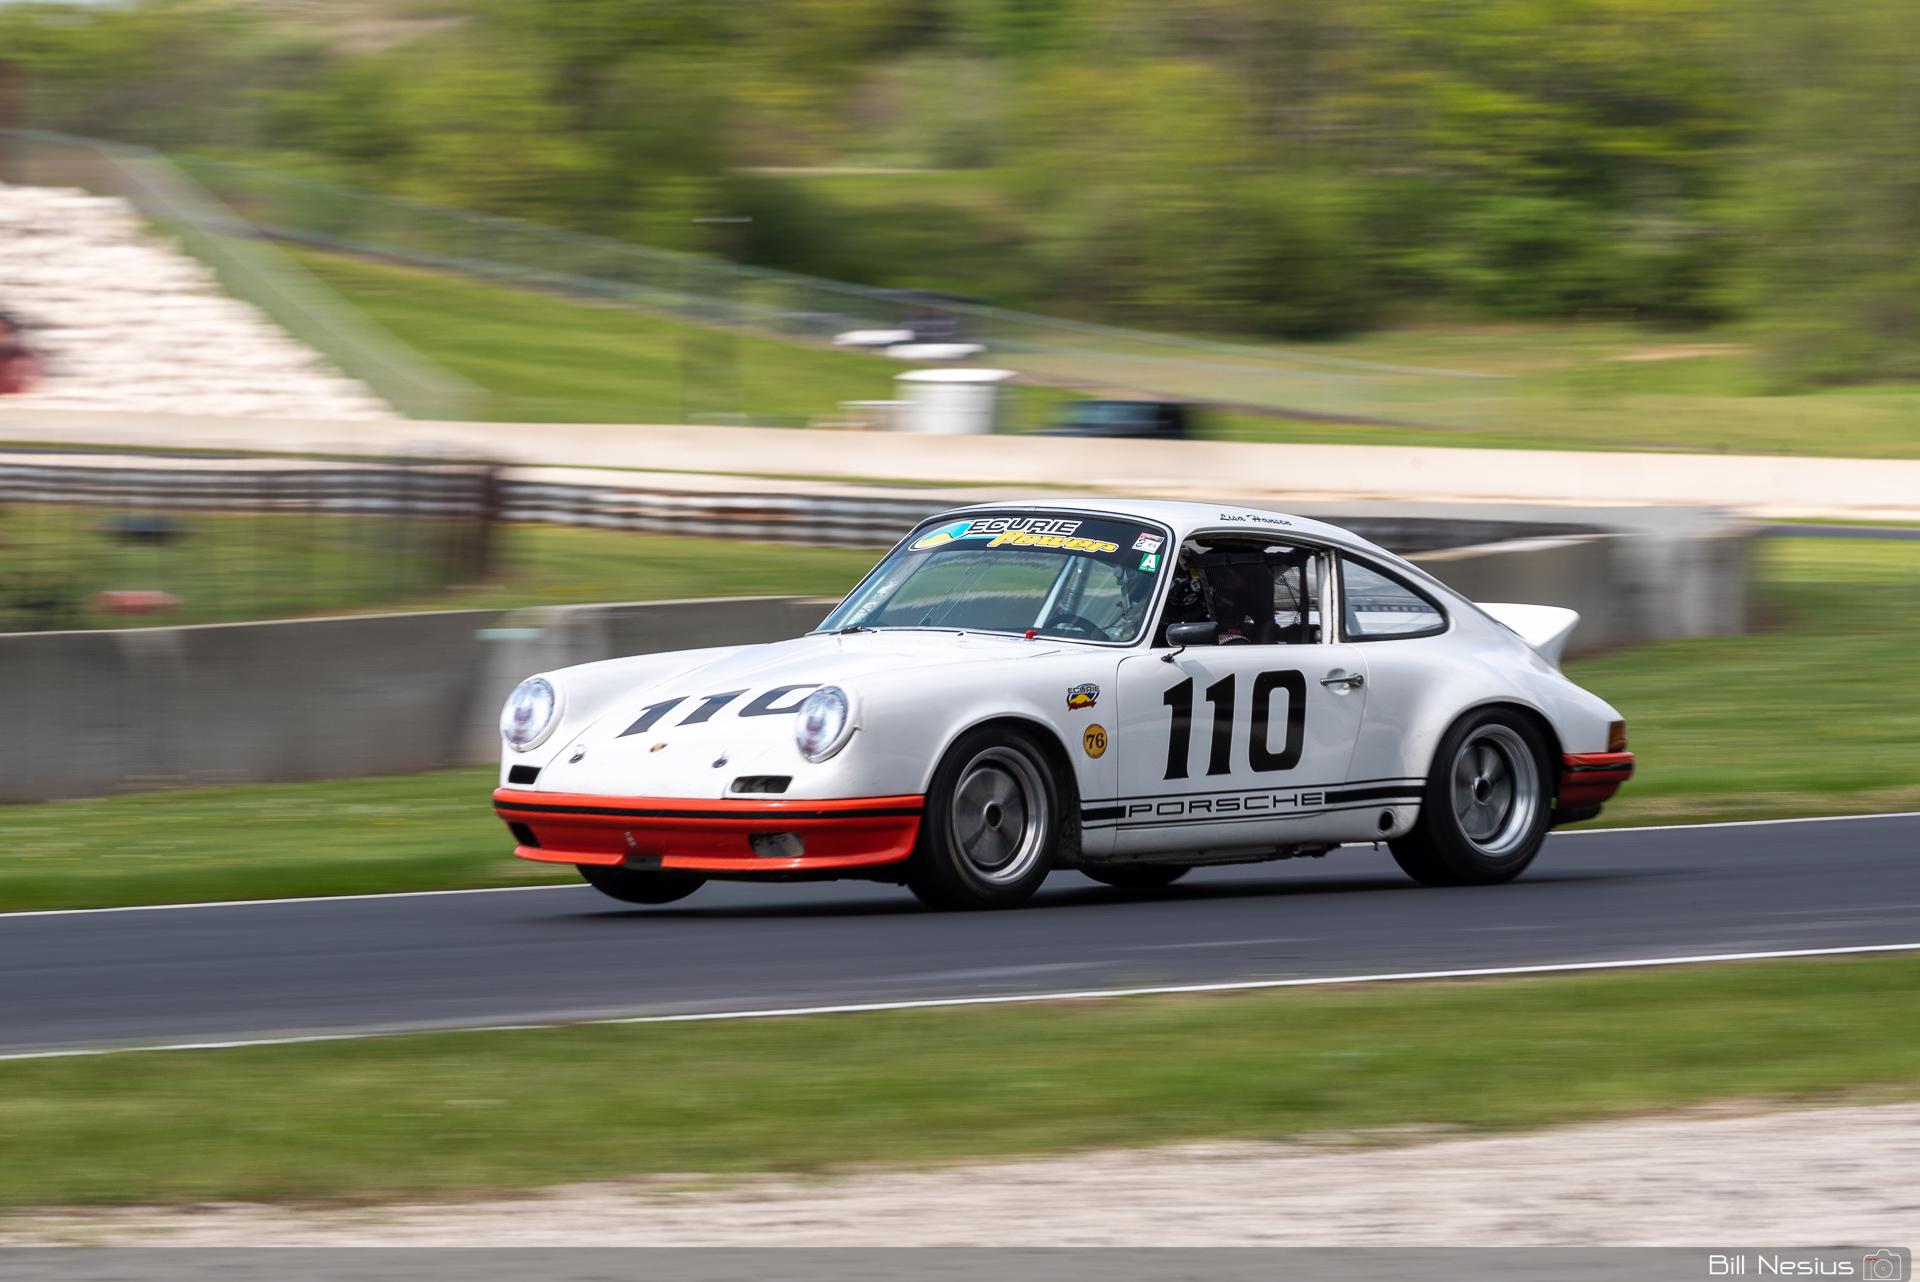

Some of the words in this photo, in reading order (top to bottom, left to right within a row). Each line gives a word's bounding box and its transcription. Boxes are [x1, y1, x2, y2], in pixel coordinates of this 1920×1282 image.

[968, 518, 1082, 535] ECURIE
[1219, 513, 1246, 522] Lisa
[1246, 514, 1292, 526] Hansen
[1141, 553, 1156, 568] A
[1067, 685, 1101, 694] ECURIE
[1163, 669, 1307, 780] 110
[1085, 732, 1105, 749] 76
[1128, 792, 1324, 818] PORSCHE
